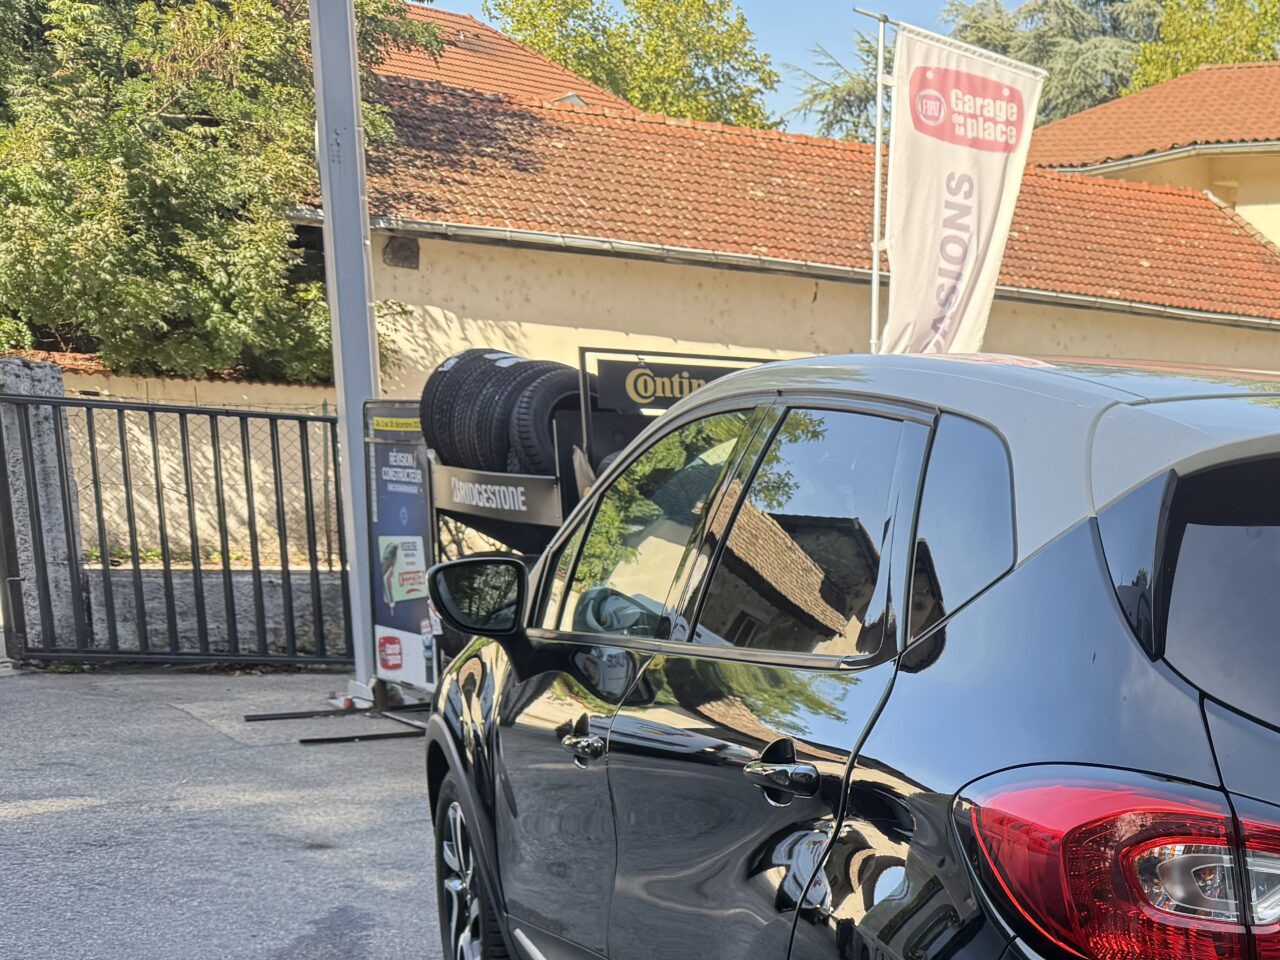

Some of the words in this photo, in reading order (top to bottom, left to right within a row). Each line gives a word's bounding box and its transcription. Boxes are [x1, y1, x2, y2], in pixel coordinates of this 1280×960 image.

[922, 99, 941, 118] FIAT
[951, 88, 1018, 122] Garage
[966, 116, 1017, 144] place
[451, 477, 527, 512] BRIDGESTONE
